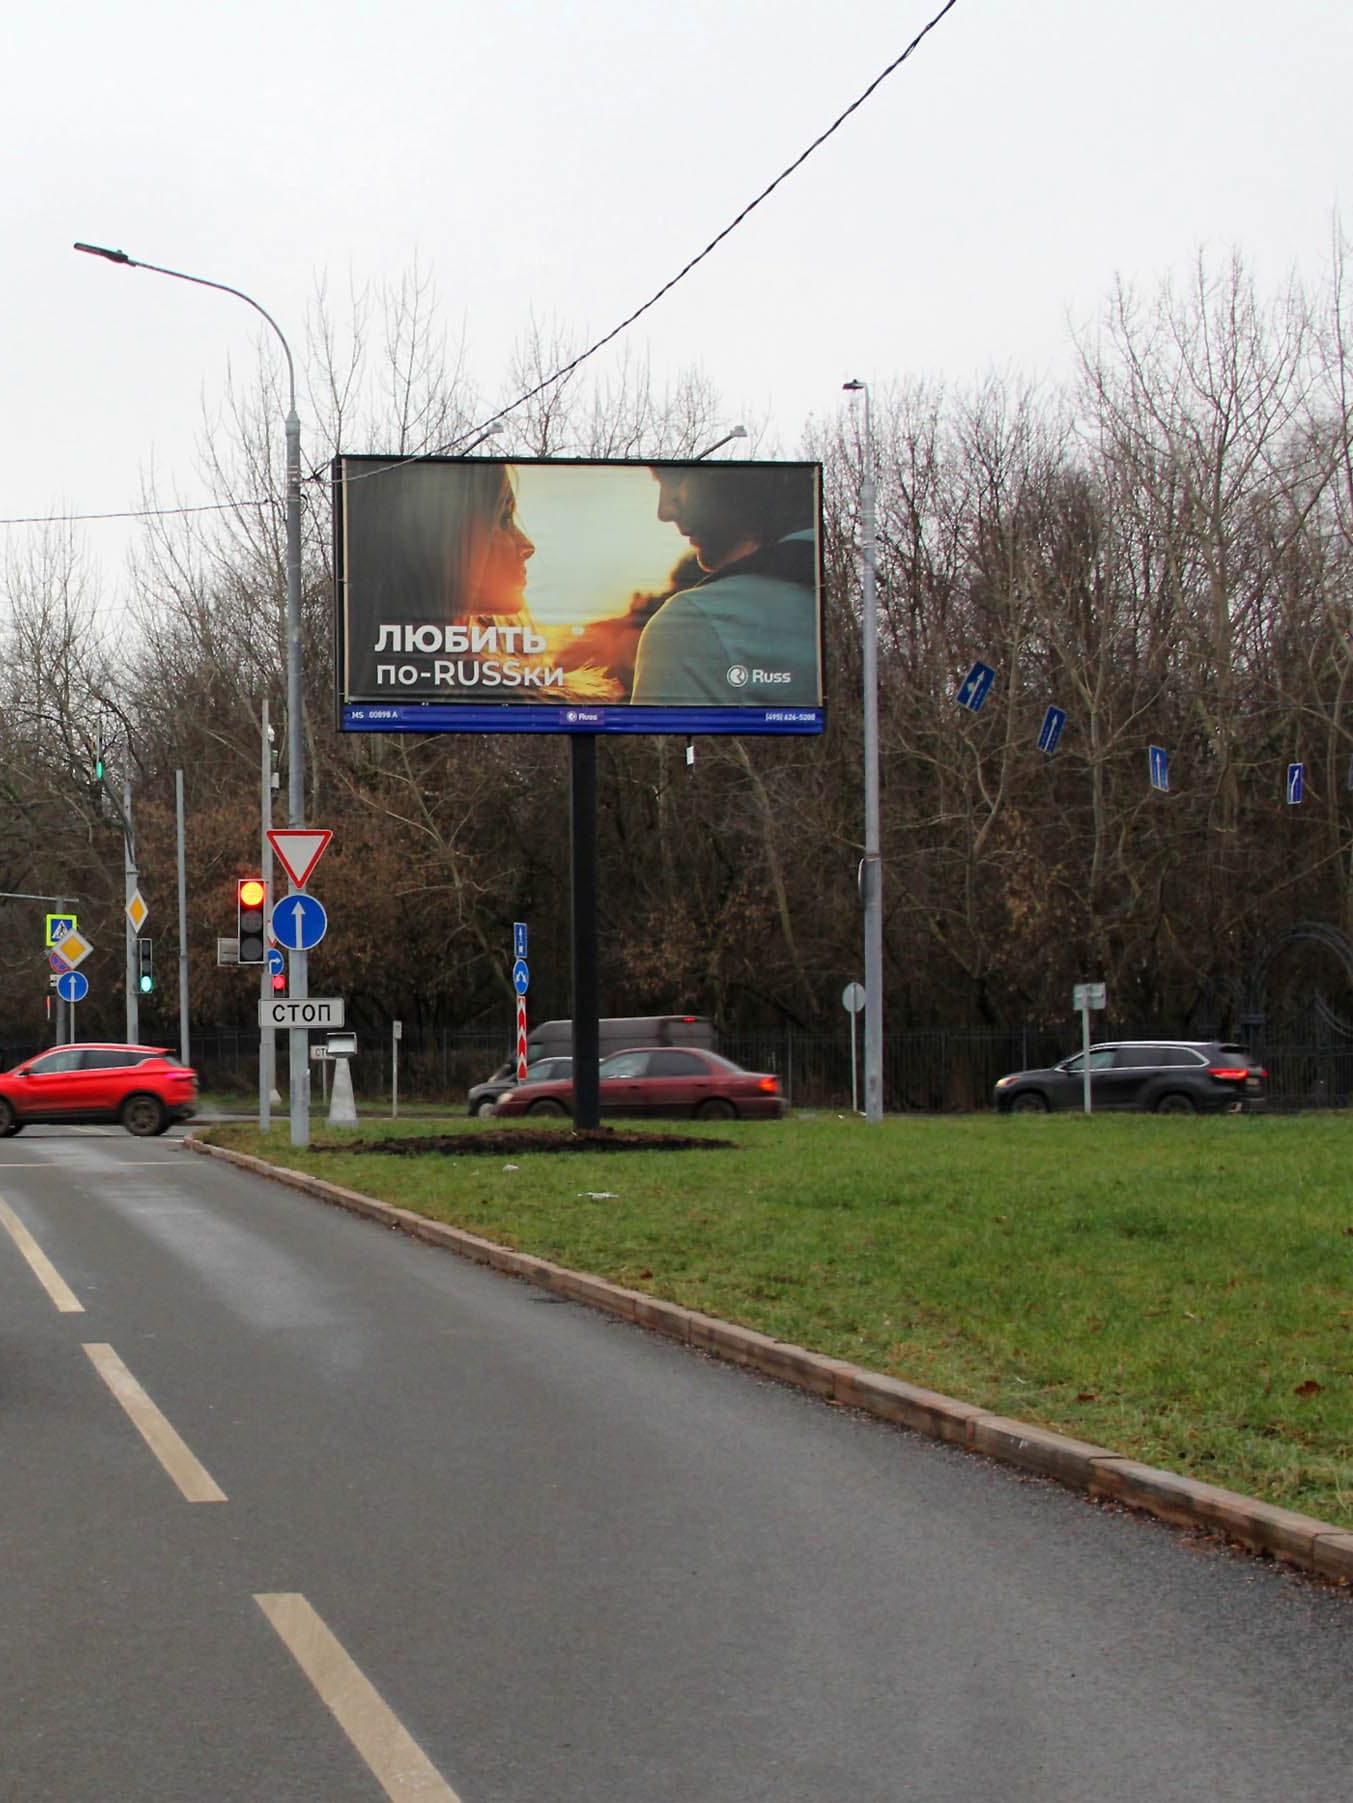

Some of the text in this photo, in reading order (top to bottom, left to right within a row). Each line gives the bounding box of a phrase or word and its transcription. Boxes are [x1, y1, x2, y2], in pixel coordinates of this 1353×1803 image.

[374, 624, 547, 654] ЛЮБИТЬ
[376, 660, 566, 687] по-RUSSки
[752, 669, 792, 684] Russ
[578, 712, 598, 721] Russ
[272, 1004, 331, 1022] СТОП
